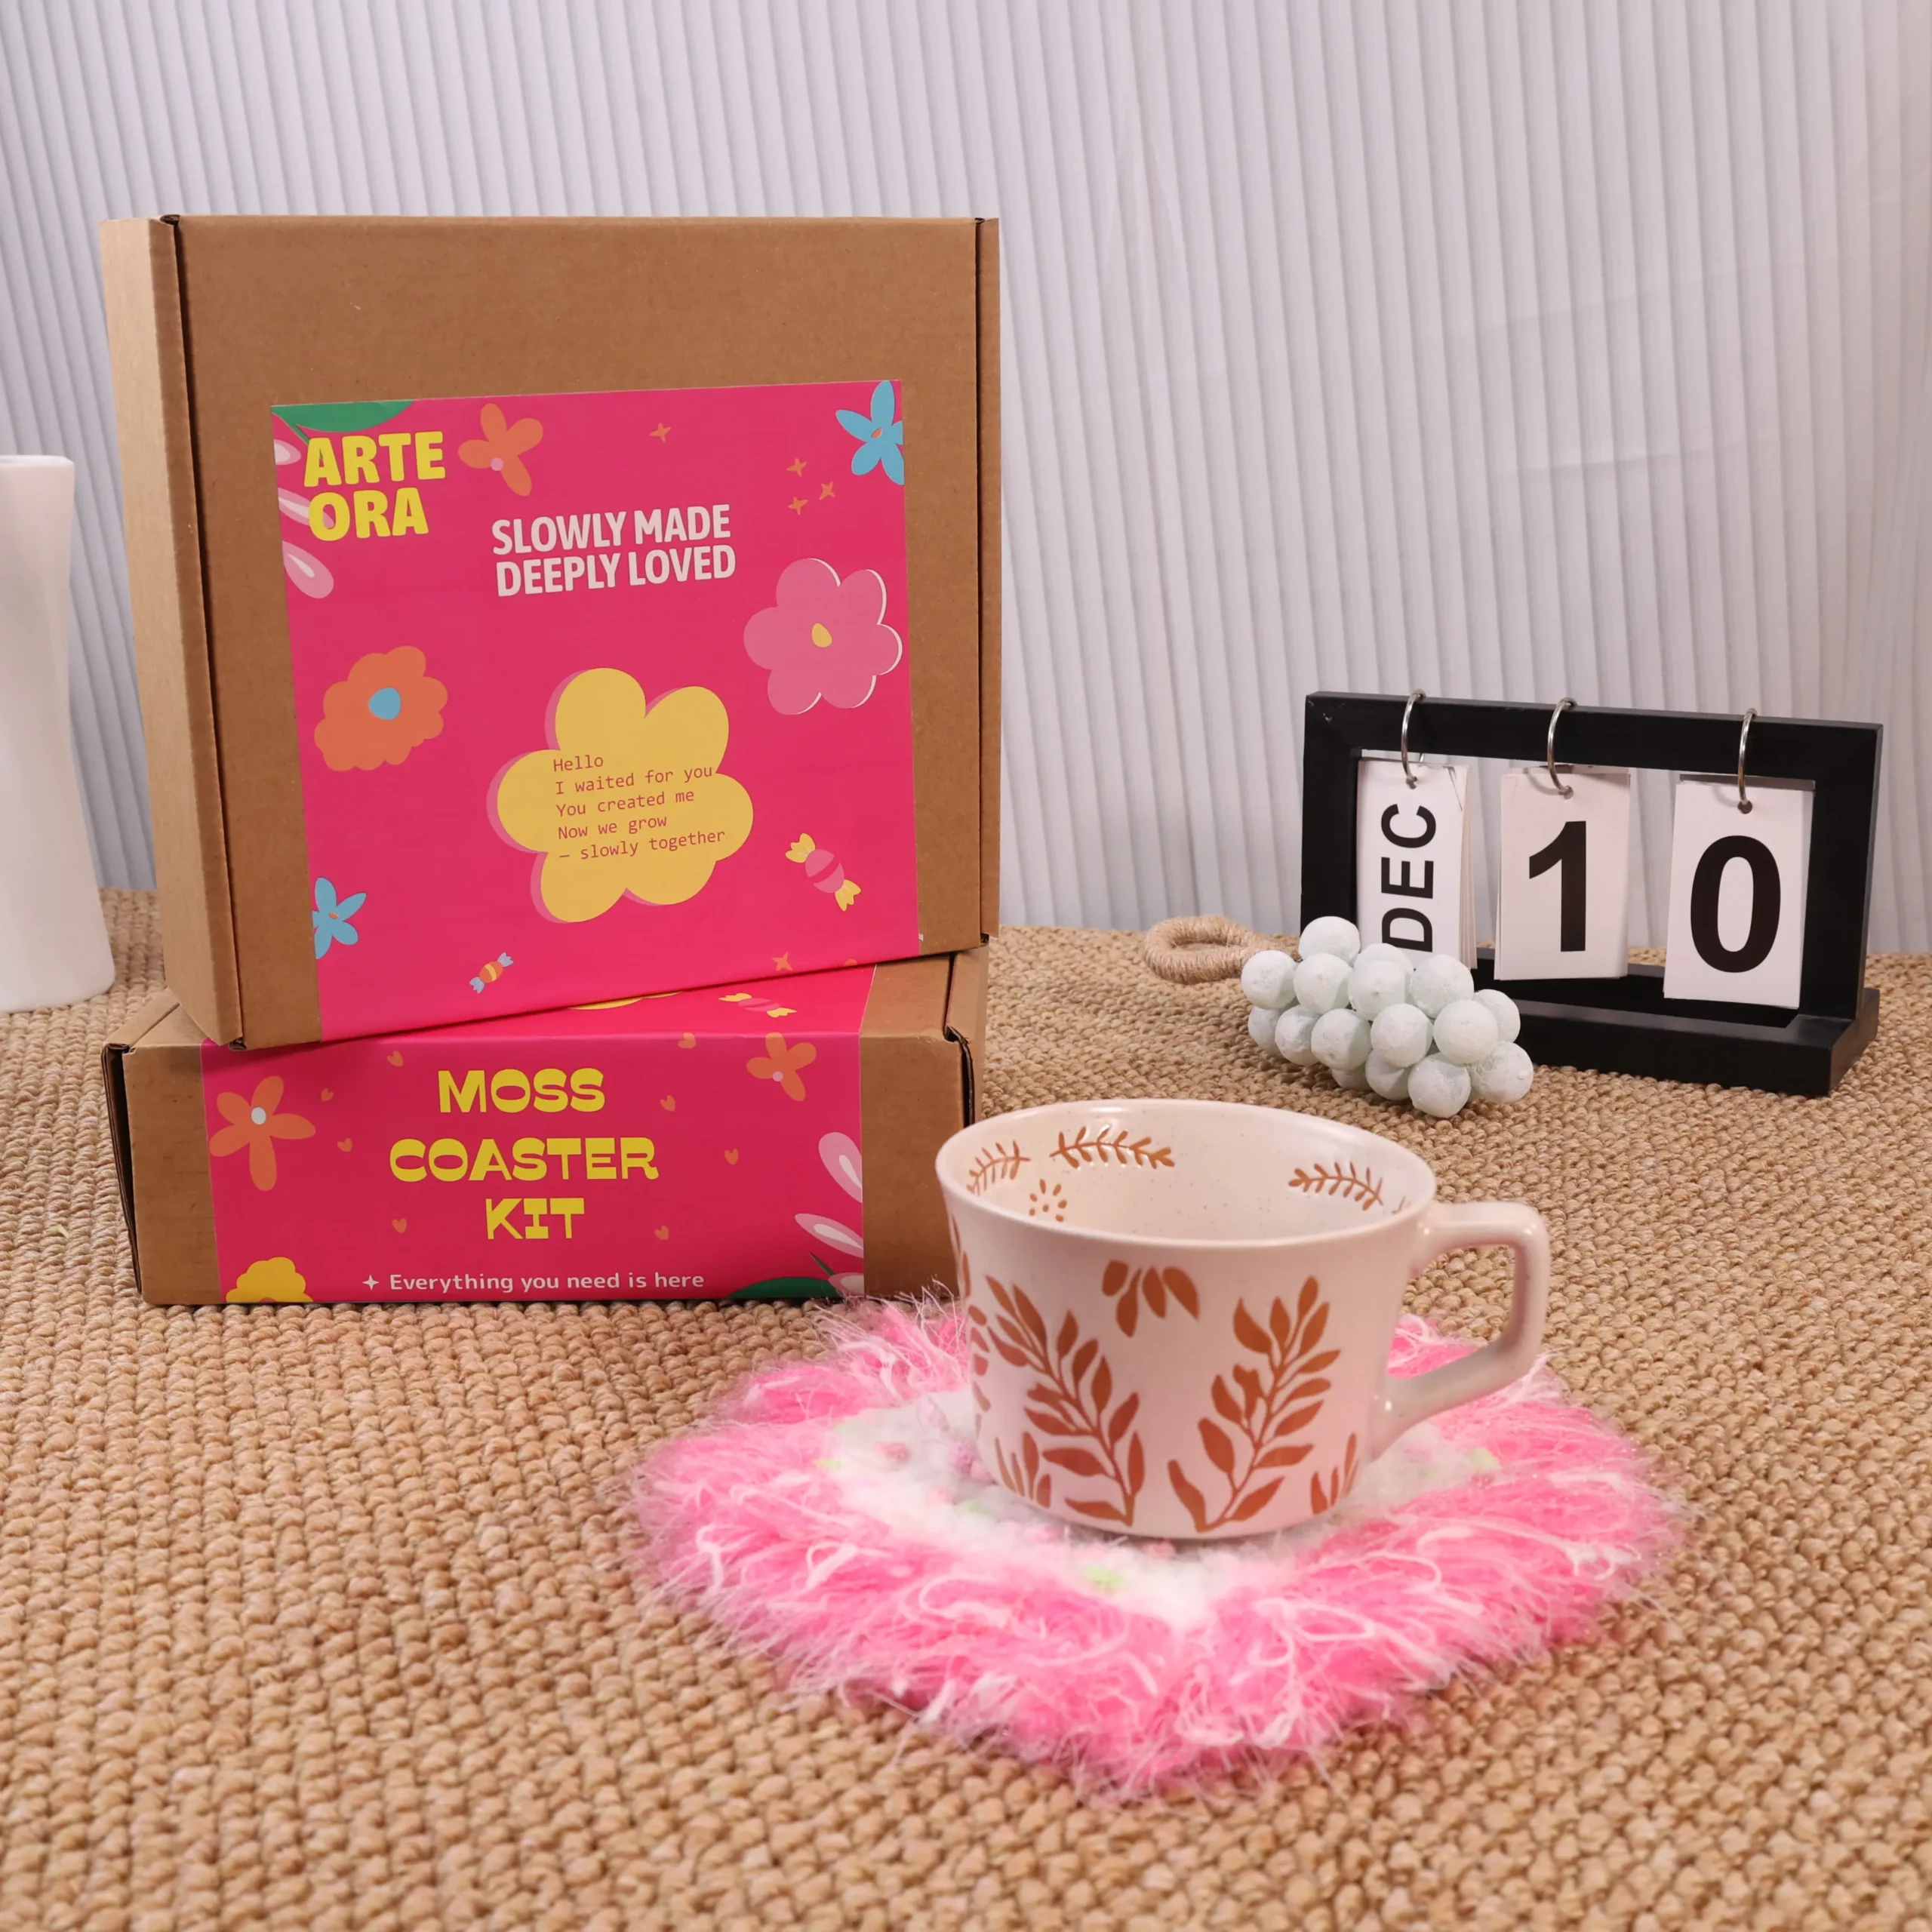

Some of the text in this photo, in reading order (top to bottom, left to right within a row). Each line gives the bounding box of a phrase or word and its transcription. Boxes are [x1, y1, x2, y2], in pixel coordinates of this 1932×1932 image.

[304, 431, 446, 488] ARTE
[309, 488, 429, 540] ORA
[492, 504, 731, 556] SLOWLY MADE
[495, 545, 736, 596] DEEPLY LOVED
[554, 755, 604, 771] Hello
[555, 767, 712, 795] I waited for you
[556, 791, 694, 817] You created me
[558, 816, 667, 839] Now we grow
[580, 840, 638, 859] slowly
[649, 831, 725, 851] together
[1381, 804, 1437, 953] DEC
[1529, 820, 1780, 973] 1 0
[438, 1067, 605, 1112] MOSS
[389, 1137, 659, 1182] COASTER
[486, 1198, 584, 1239] KIT
[390, 1272, 705, 1293] Everything you need is here
